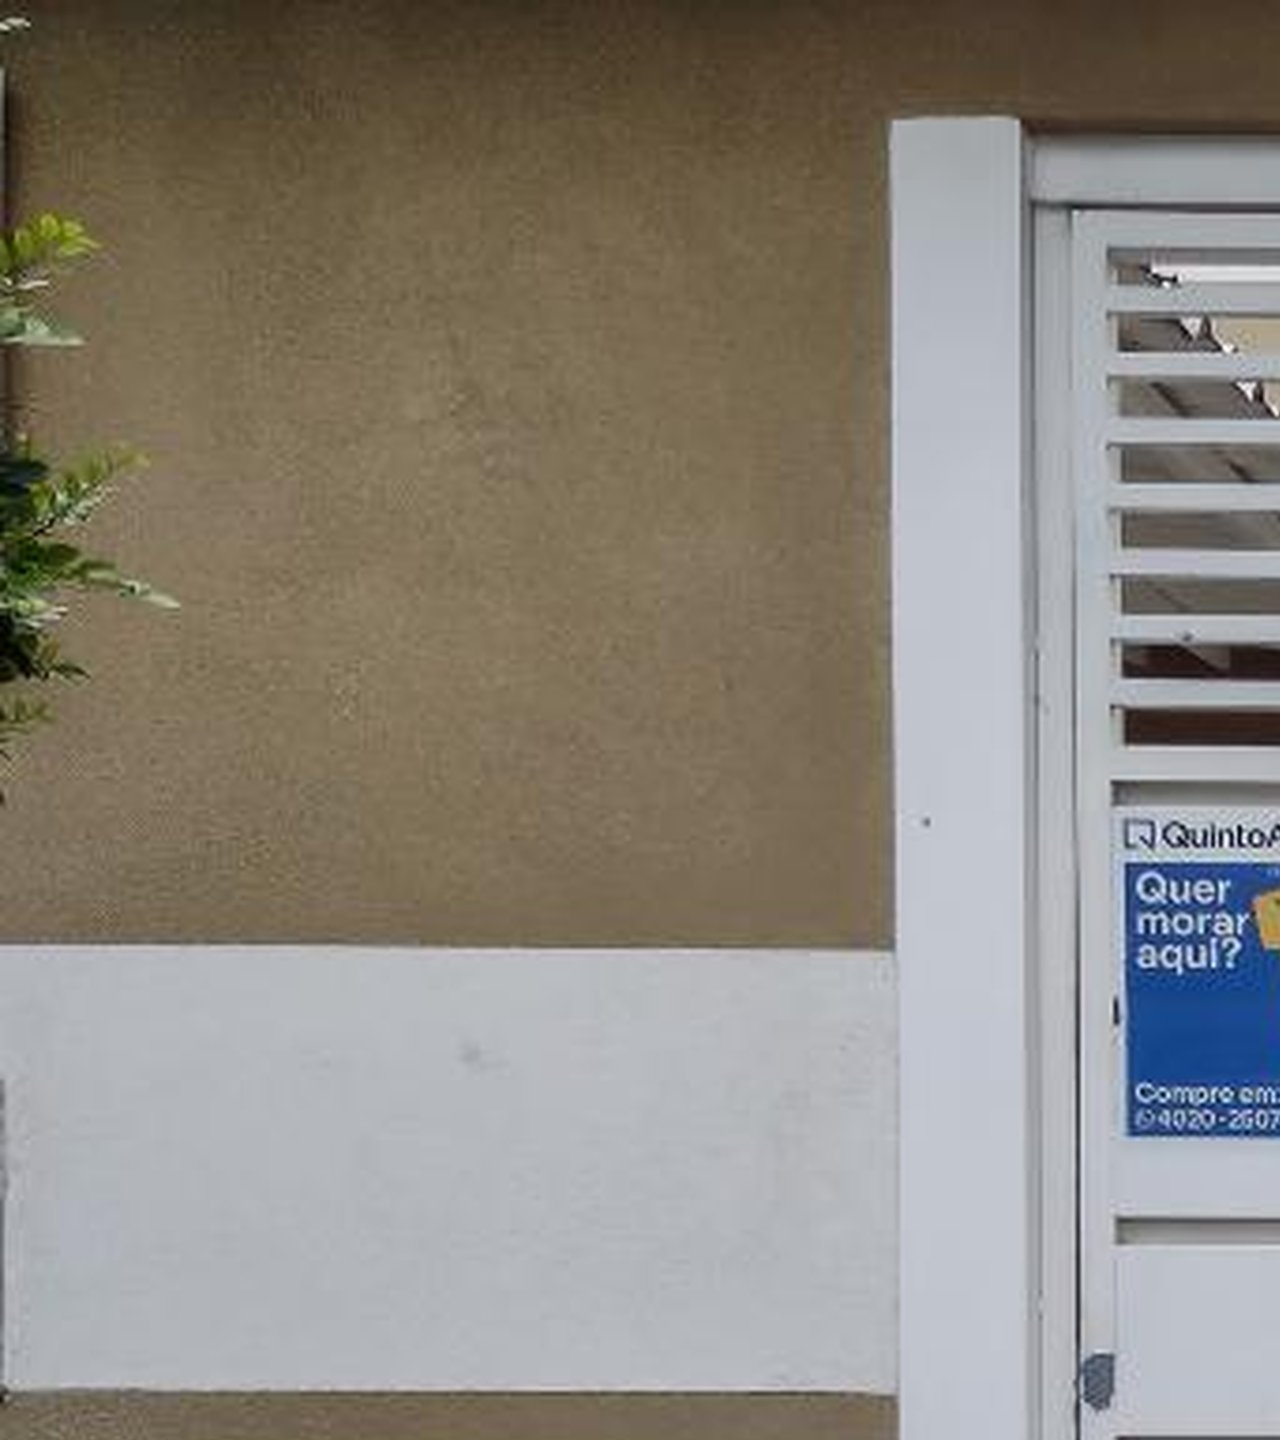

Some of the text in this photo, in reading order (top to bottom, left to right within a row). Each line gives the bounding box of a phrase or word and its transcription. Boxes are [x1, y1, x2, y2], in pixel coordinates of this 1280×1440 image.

[1136, 872, 1231, 905] Quer
[1136, 911, 1250, 936] morar
[1136, 936, 1242, 975] aqui?
[1134, 1082, 1236, 1106] Compre
